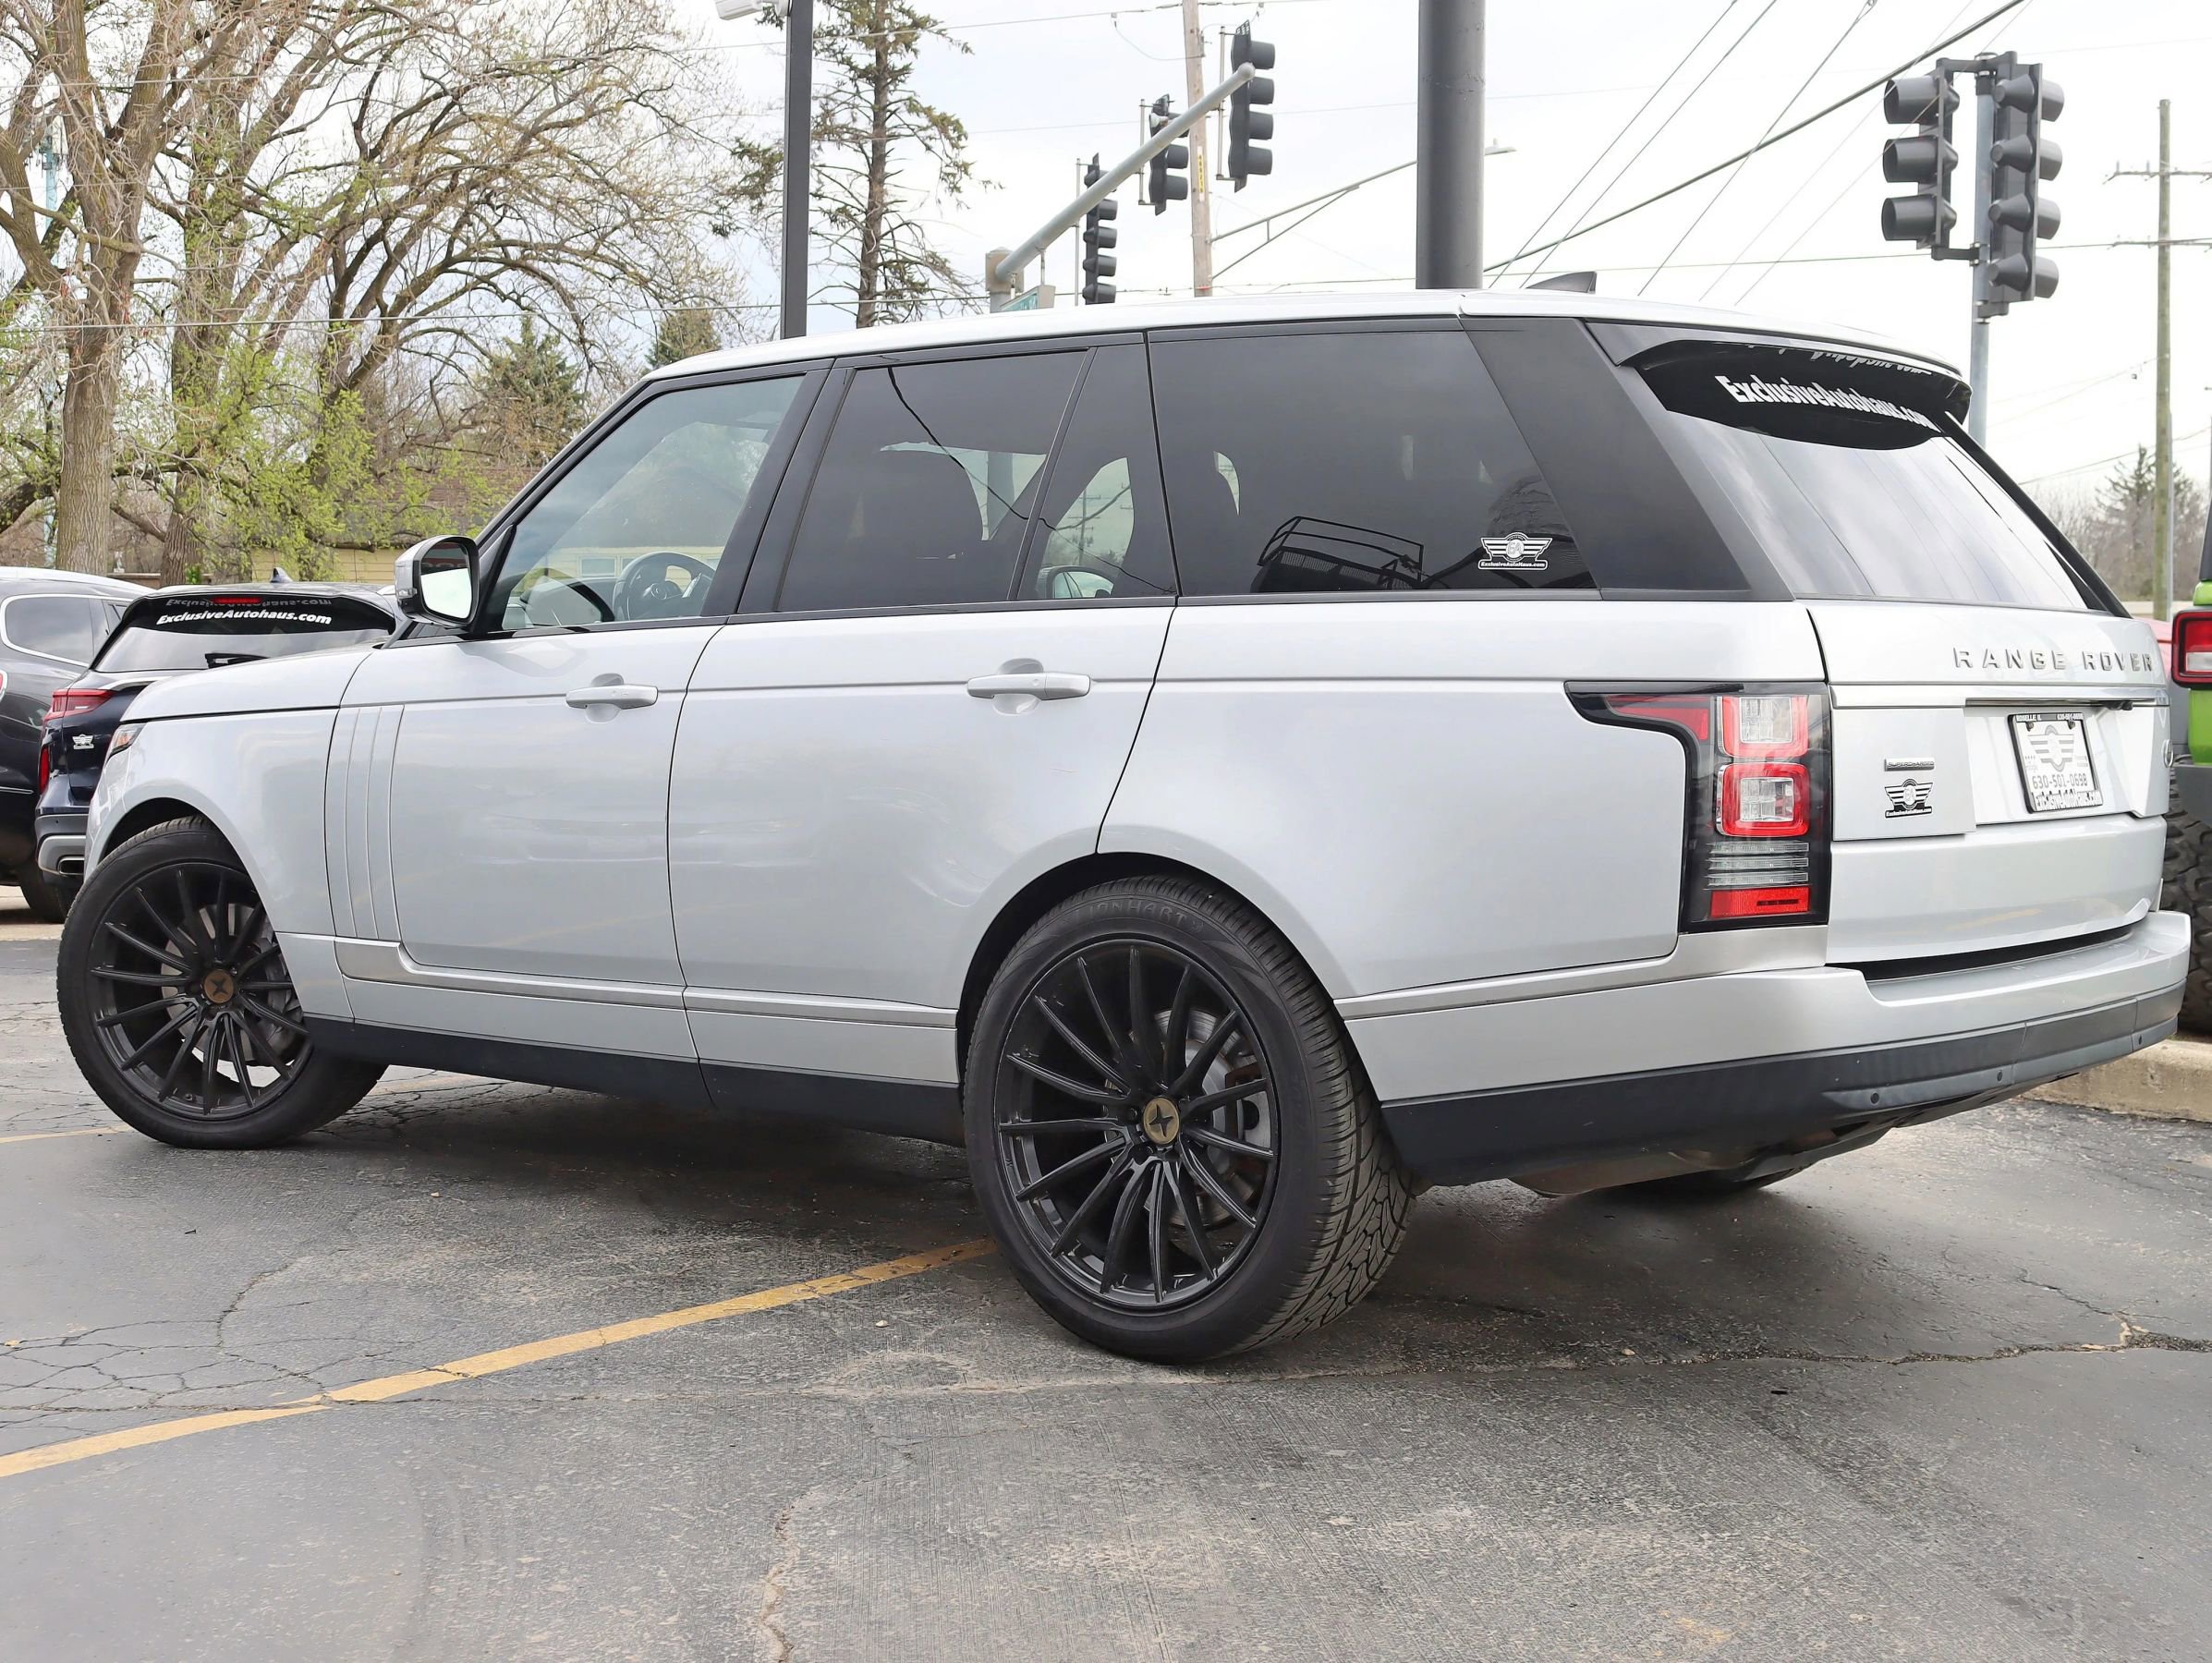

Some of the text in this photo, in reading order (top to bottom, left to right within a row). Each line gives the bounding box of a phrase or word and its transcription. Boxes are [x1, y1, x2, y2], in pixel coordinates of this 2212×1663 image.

[156, 609, 332, 625] ExclusiveAutohaus.com
[1952, 647, 2153, 672] RANGE ROVER
[2032, 772, 2088, 789] 630-501-0698
